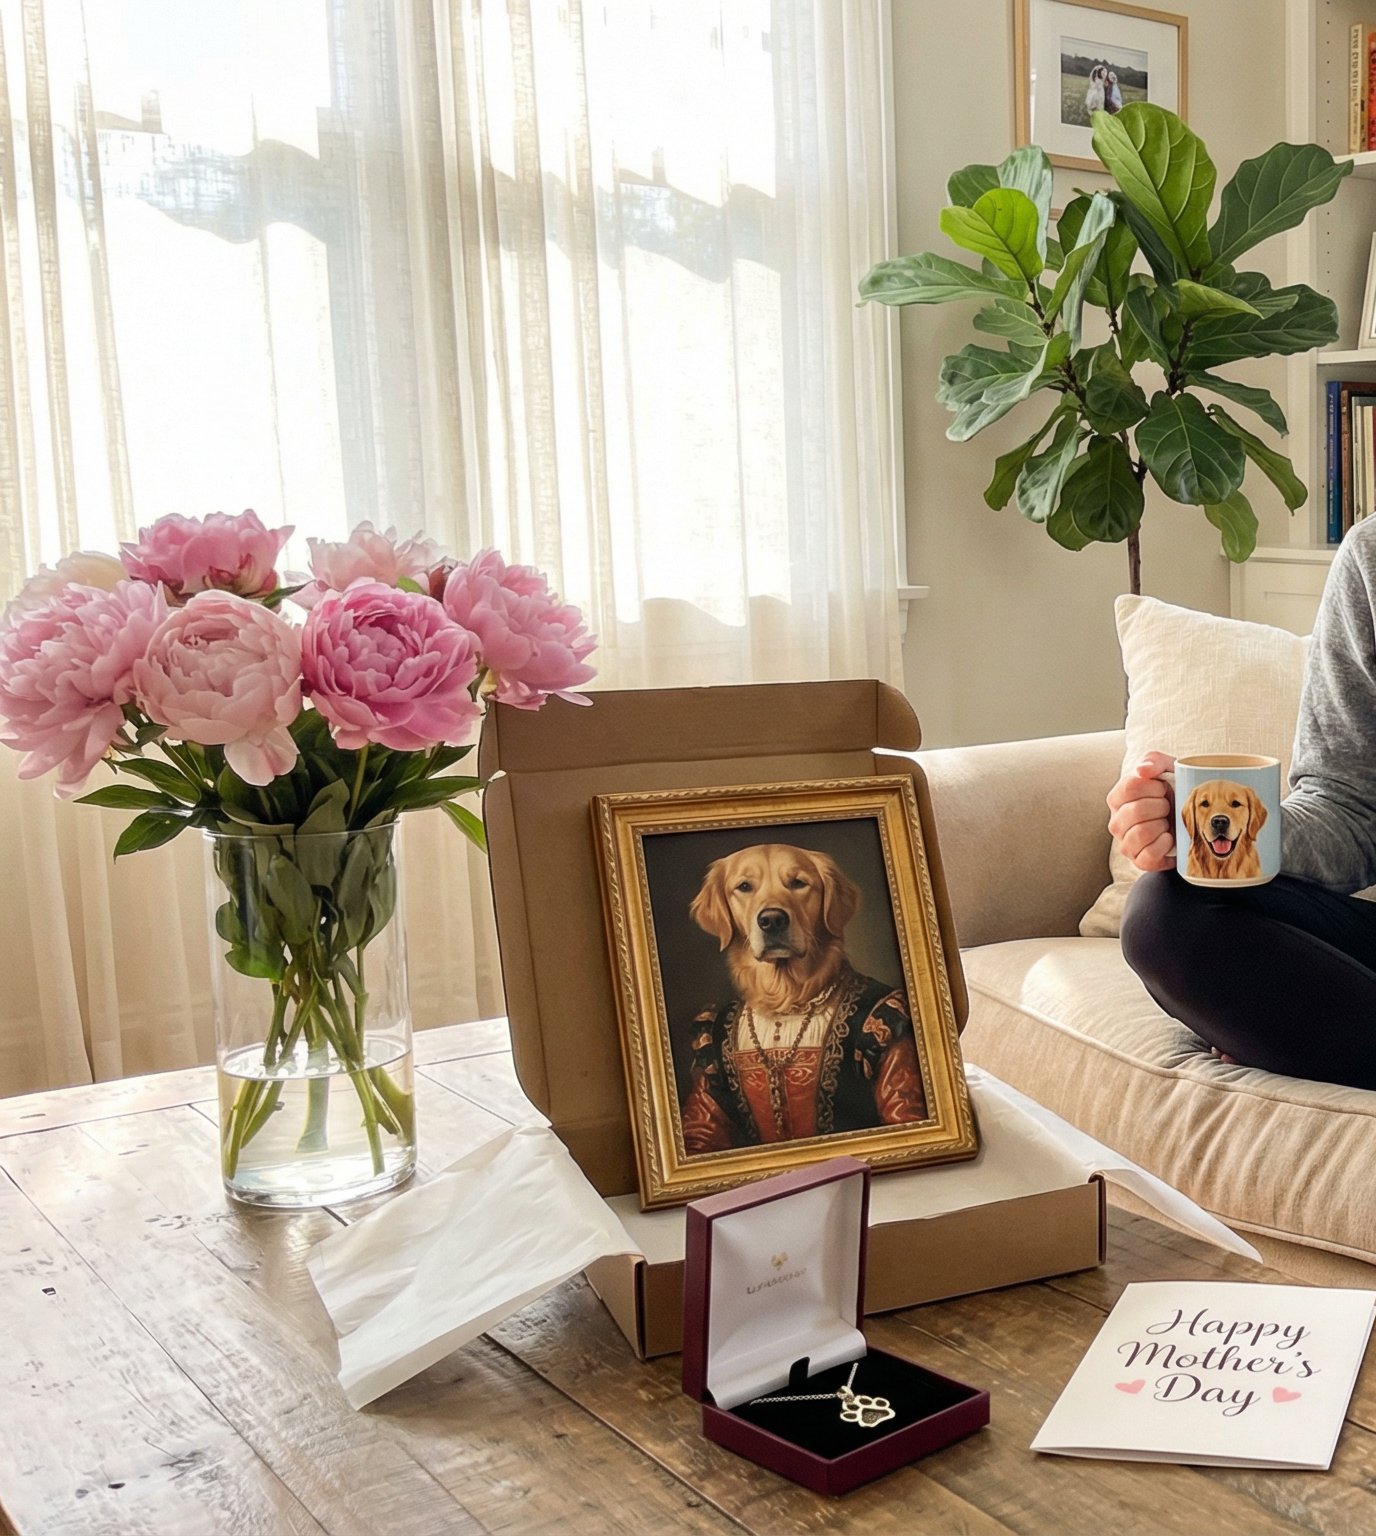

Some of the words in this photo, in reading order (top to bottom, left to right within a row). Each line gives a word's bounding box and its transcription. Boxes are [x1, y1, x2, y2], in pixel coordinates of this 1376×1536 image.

[1146, 1308, 1311, 1349] Happy
[1117, 1341, 1322, 1379] Mother's
[1153, 1373, 1261, 1417] Day
